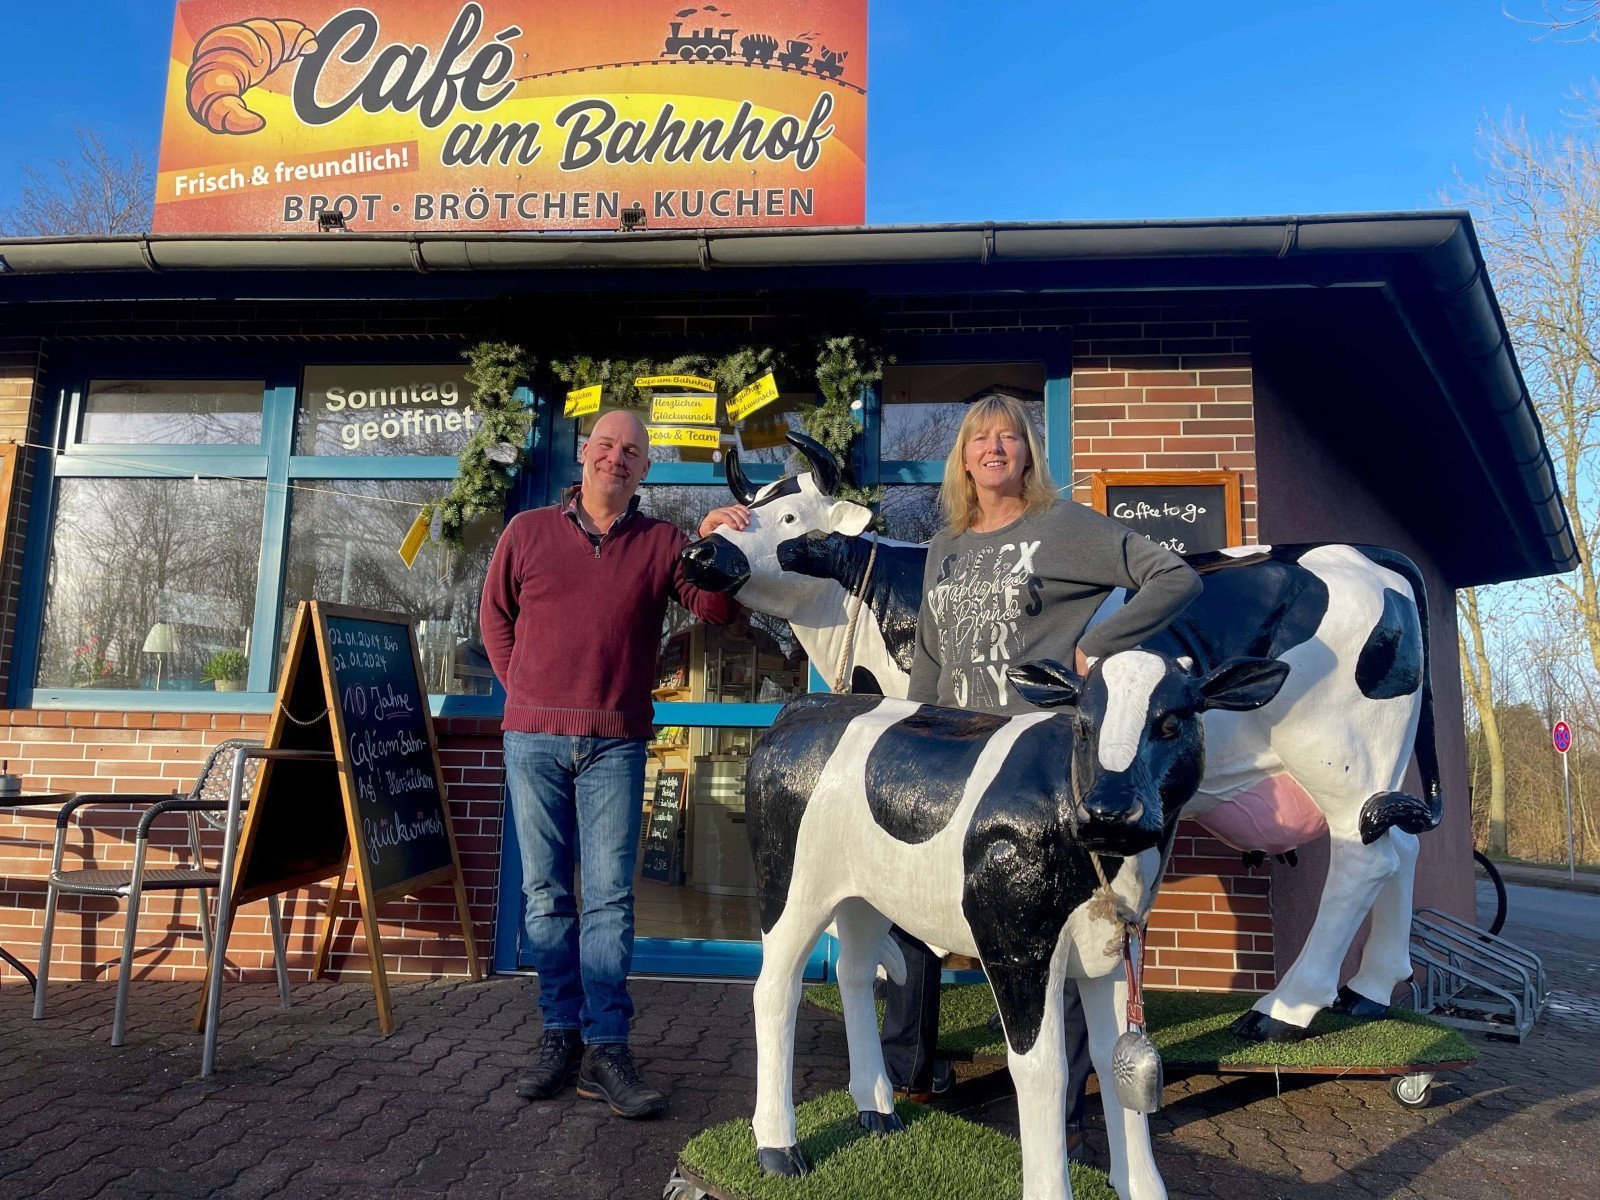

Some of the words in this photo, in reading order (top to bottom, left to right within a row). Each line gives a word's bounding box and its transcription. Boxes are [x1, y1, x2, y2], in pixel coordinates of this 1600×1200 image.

[291, 1, 523, 128] Café
[441, 122, 543, 168] am
[555, 91, 834, 172] Bahnhof
[174, 172, 245, 196] Frisch
[252, 164, 269, 185] &
[274, 147, 409, 184] freundlich!
[283, 194, 382, 222] BROT
[413, 187, 620, 221] BRÖTCHEN
[653, 187, 815, 218] KUCHEN
[325, 380, 460, 412] Sonntag
[673, 376, 714, 391] Bahnhof
[653, 411, 714, 422] Glückwunsch
[654, 398, 703, 409] Herzlichen
[340, 404, 475, 450] geöffnet
[674, 429, 683, 440] &
[685, 430, 719, 442] Team
[1113, 501, 1162, 520] Coffee
[1162, 503, 1180, 516] to
[1180, 503, 1207, 523] go
[343, 683, 367, 718] 10
[370, 683, 414, 721] Jahre
